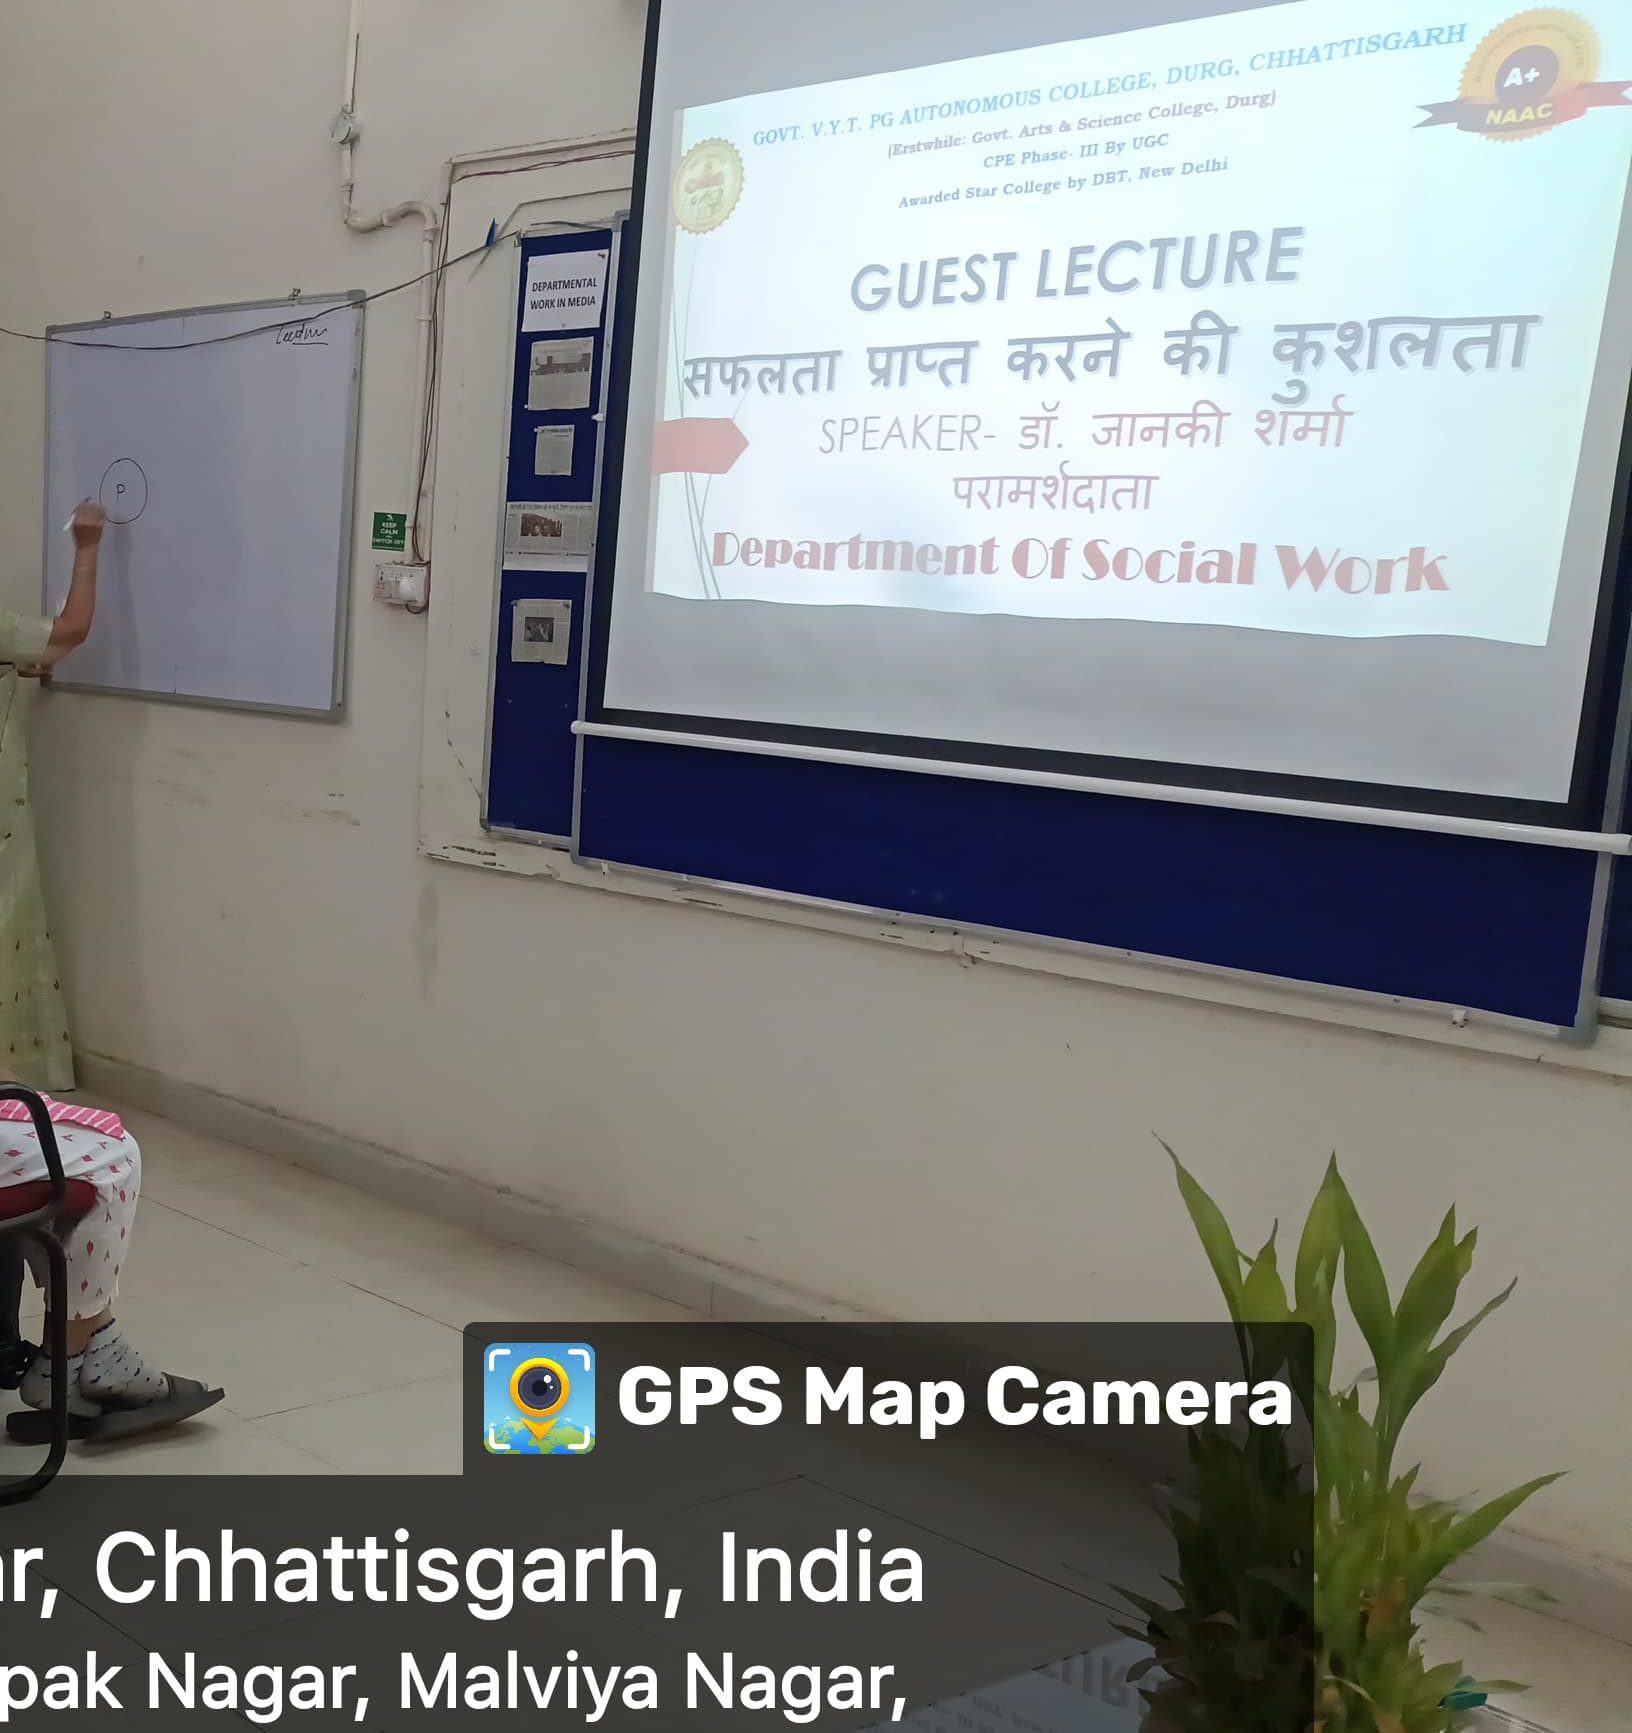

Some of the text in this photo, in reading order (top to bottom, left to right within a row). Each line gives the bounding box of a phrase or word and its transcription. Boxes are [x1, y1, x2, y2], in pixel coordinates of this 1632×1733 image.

[753, 126, 805, 146] GOVT.
[812, 117, 864, 138] V.Y.T.
[869, 112, 894, 130] PG
[900, 89, 1042, 127] AUTONOMOUS
[1048, 71, 1157, 103] COLLEGE,
[1166, 58, 1240, 86] DURG,
[1248, 22, 1468, 73] CHHATTISGARH
[1503, 67, 1540, 88] A+
[971, 126, 1013, 146] Govt.
[1018, 120, 1054, 138] Arts
[1058, 118, 1073, 133] &
[1077, 109, 1142, 132] Science
[1147, 96, 1218, 121] College,
[1225, 88, 1277, 111] Durg)
[1485, 103, 1554, 126] NAAC
[983, 133, 1169, 169] CPE Phase- III By UGC
[897, 156, 1229, 209] Awarded Star College by DBT, New Delhi
[532, 277, 597, 292] DEPARTMENTAL
[850, 226, 1306, 312] GUEST LECTURE
[530, 296, 596, 310] WORK IN MEDIA
[683, 309, 1544, 407] सफलता प्राप्त करने की कुशलता
[819, 394, 1355, 455] SPEAKER- डॉ. जानकी शर्मा
[953, 460, 1160, 514] परामर्शदाता
[711, 531, 1452, 595] Department Of Social Work
